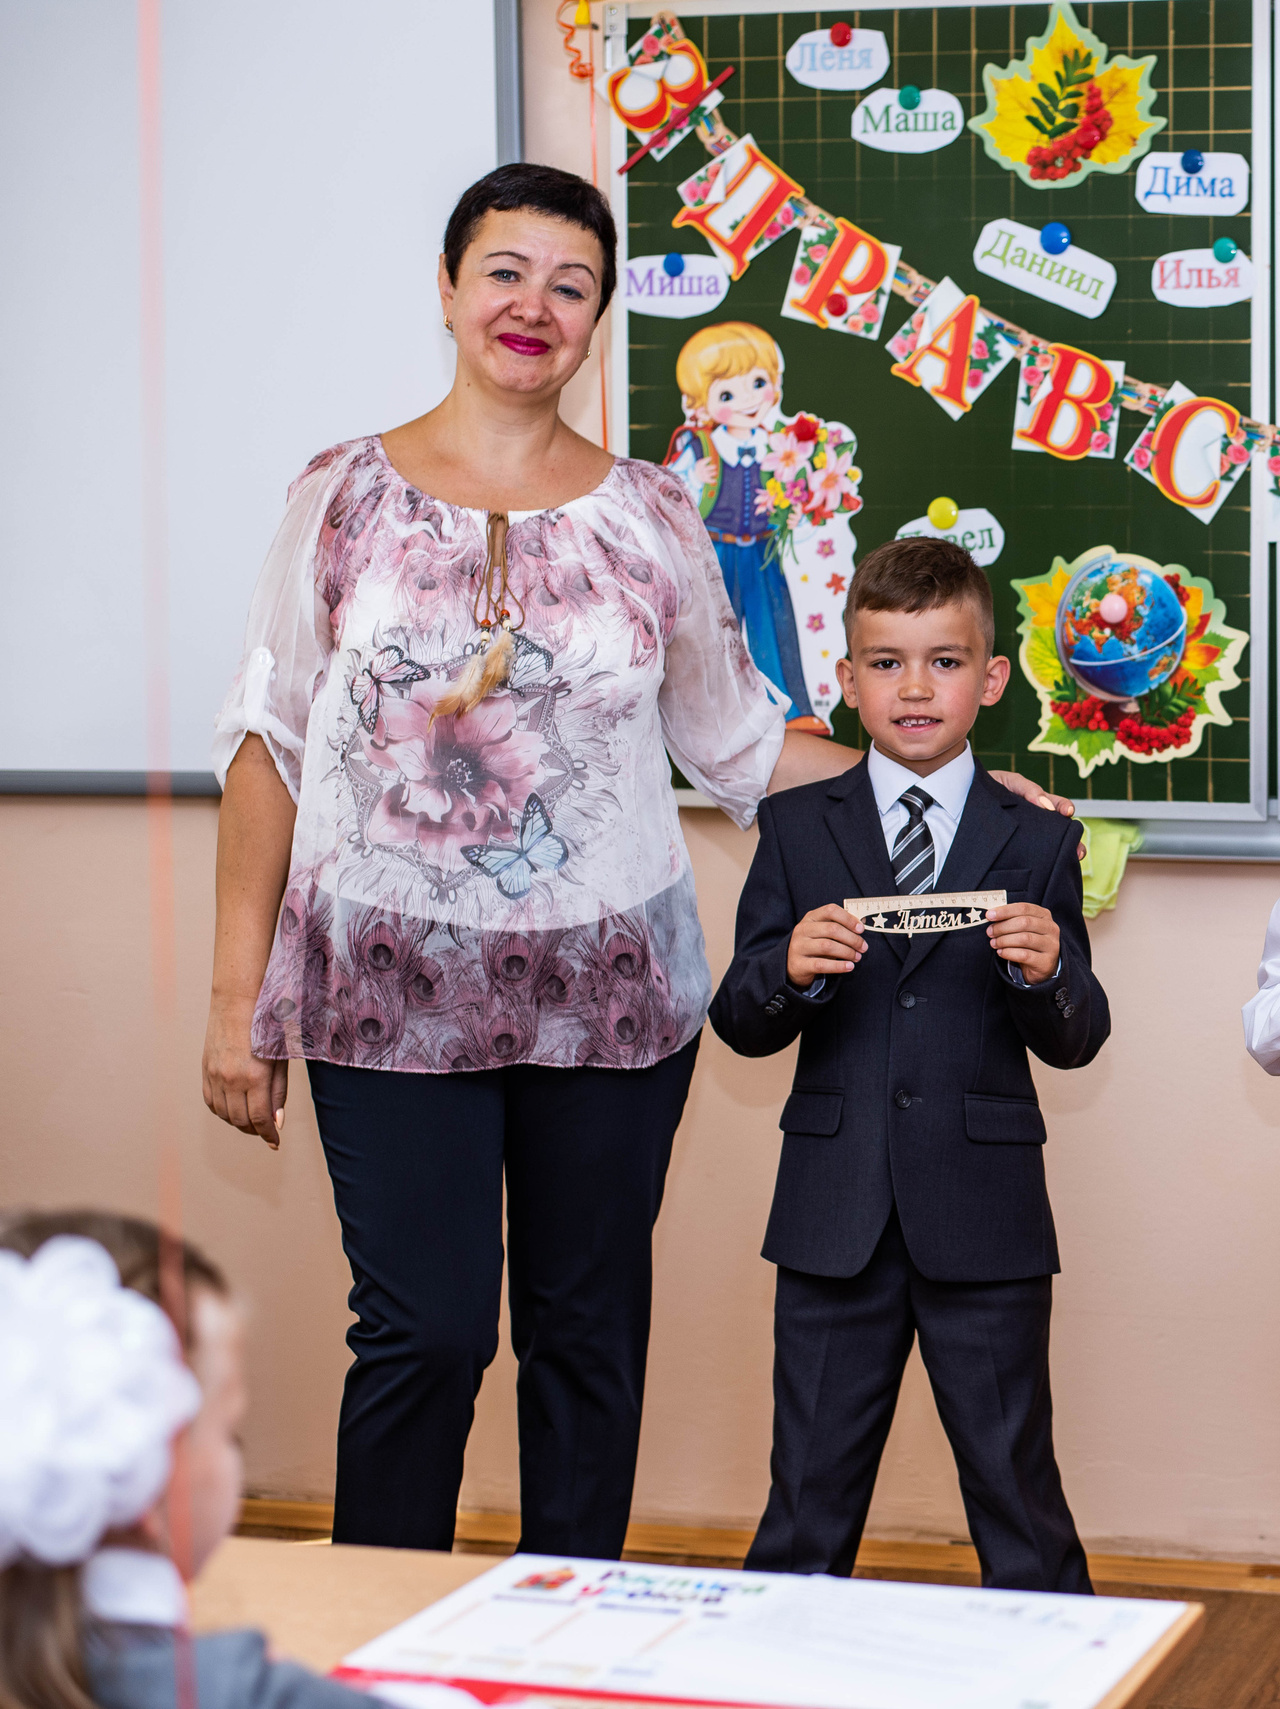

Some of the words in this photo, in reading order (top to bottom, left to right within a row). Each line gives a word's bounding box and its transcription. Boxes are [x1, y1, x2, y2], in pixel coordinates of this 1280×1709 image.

[794, 42, 874, 72] Лёня
[861, 104, 957, 134] Маша
[1143, 166, 1236, 202] Дима
[981, 229, 1105, 301] Даниил
[1156, 259, 1241, 290] Илья
[625, 267, 721, 297] Миша
[894, 909, 965, 938] Артём
